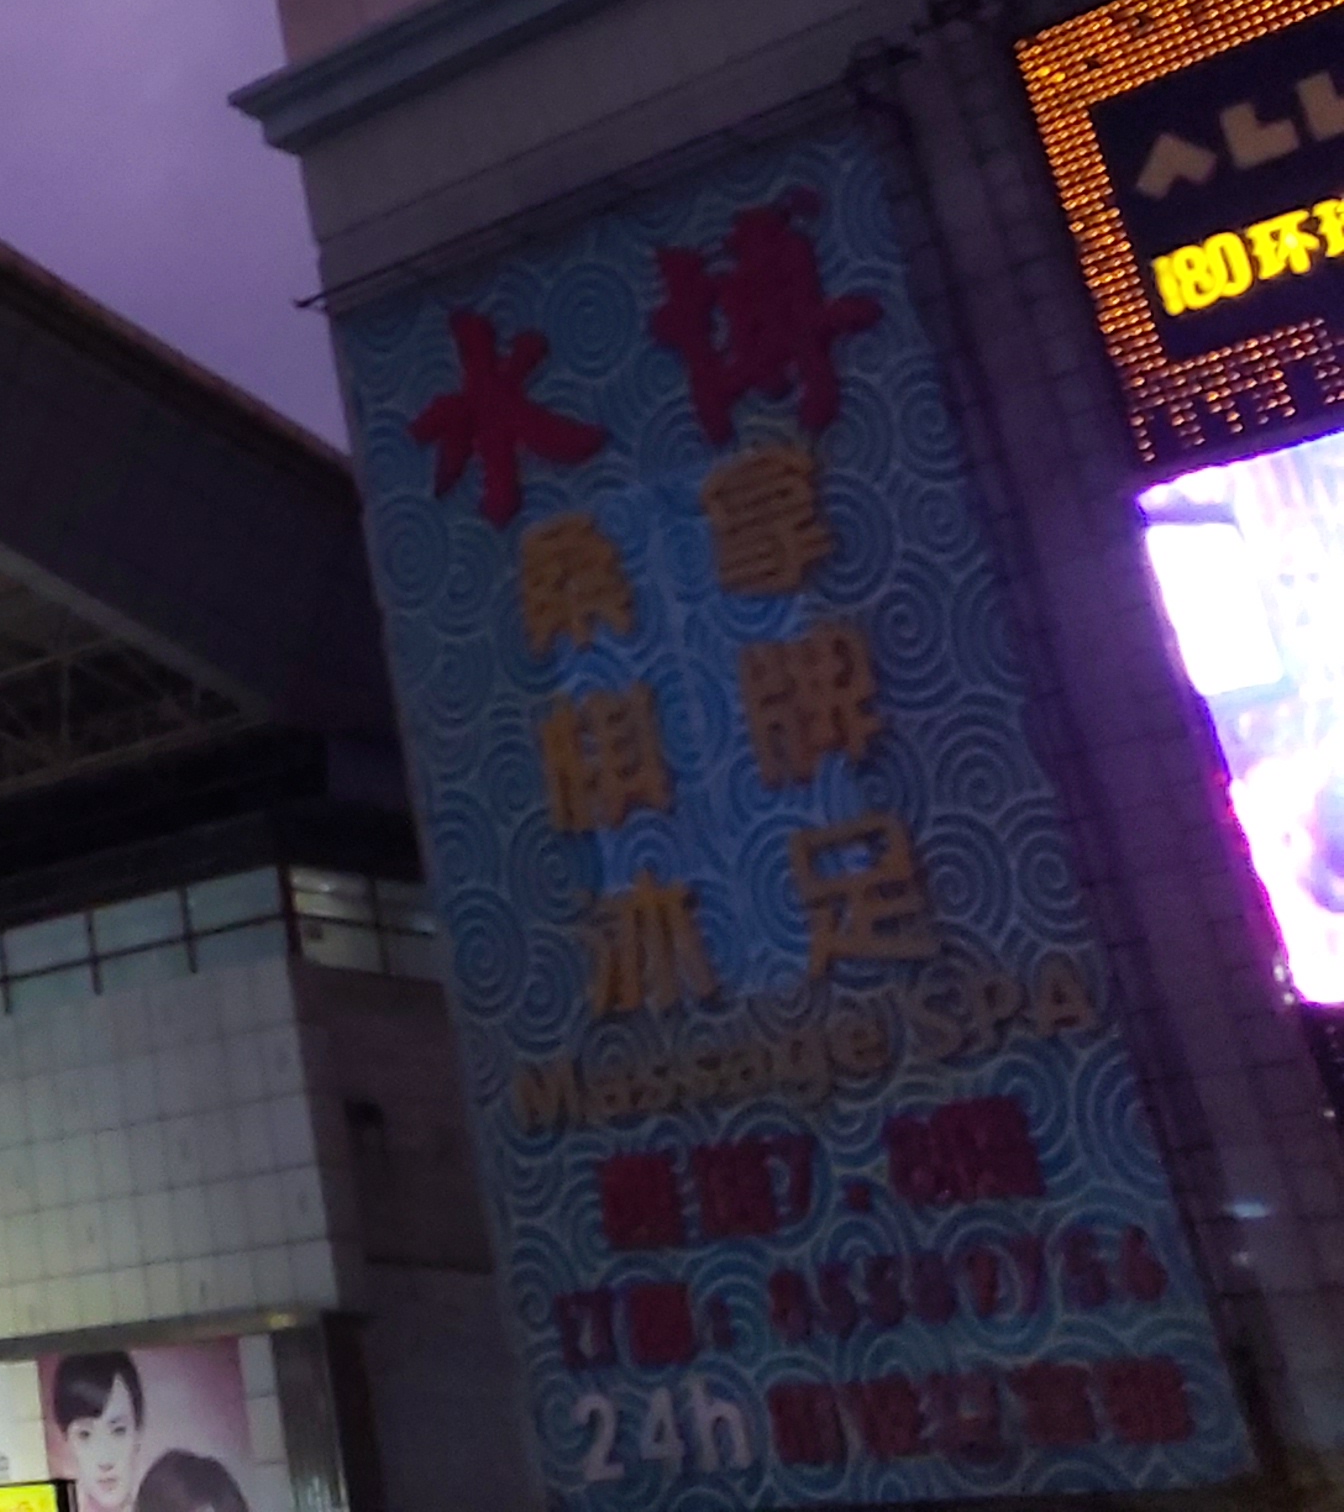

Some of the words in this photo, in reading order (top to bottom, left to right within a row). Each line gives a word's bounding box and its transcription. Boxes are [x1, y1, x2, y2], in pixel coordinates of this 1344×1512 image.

[512, 1007, 893, 1129] Massage
[912, 954, 1103, 1063] SPA
[573, 1376, 756, 1482] 24h
